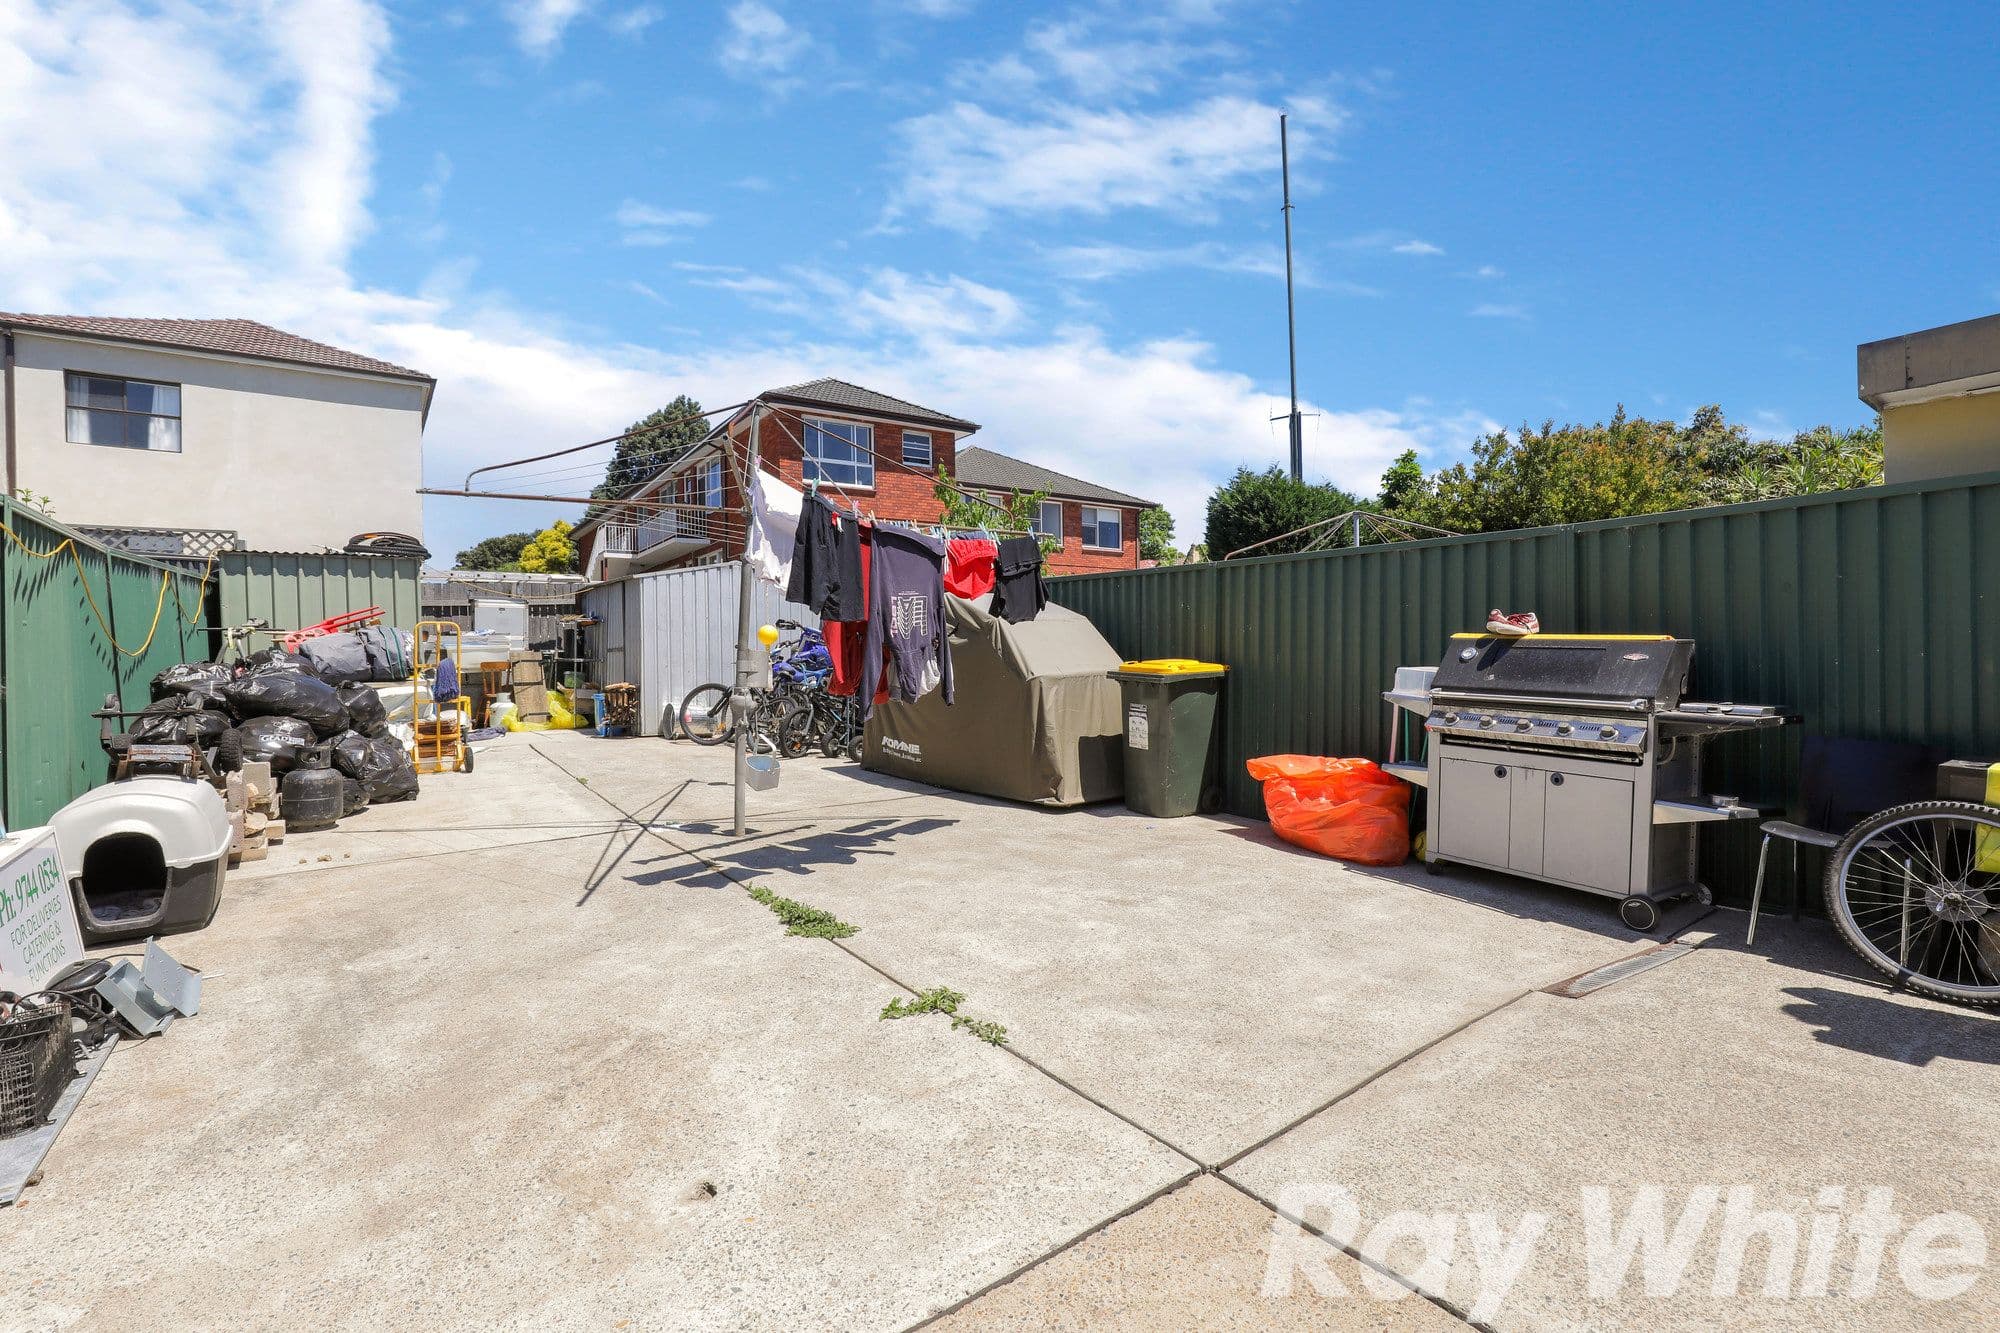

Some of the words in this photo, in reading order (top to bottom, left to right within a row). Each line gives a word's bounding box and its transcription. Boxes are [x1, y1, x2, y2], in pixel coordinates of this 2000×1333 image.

[15, 868, 39, 913] 9744
[38, 853, 60, 894] 0534
[10, 924, 28, 949] FOR
[26, 895, 62, 936] DELIVERIES
[23, 924, 55, 964] CATERING
[28, 940, 66, 987] FUNCTIONS
